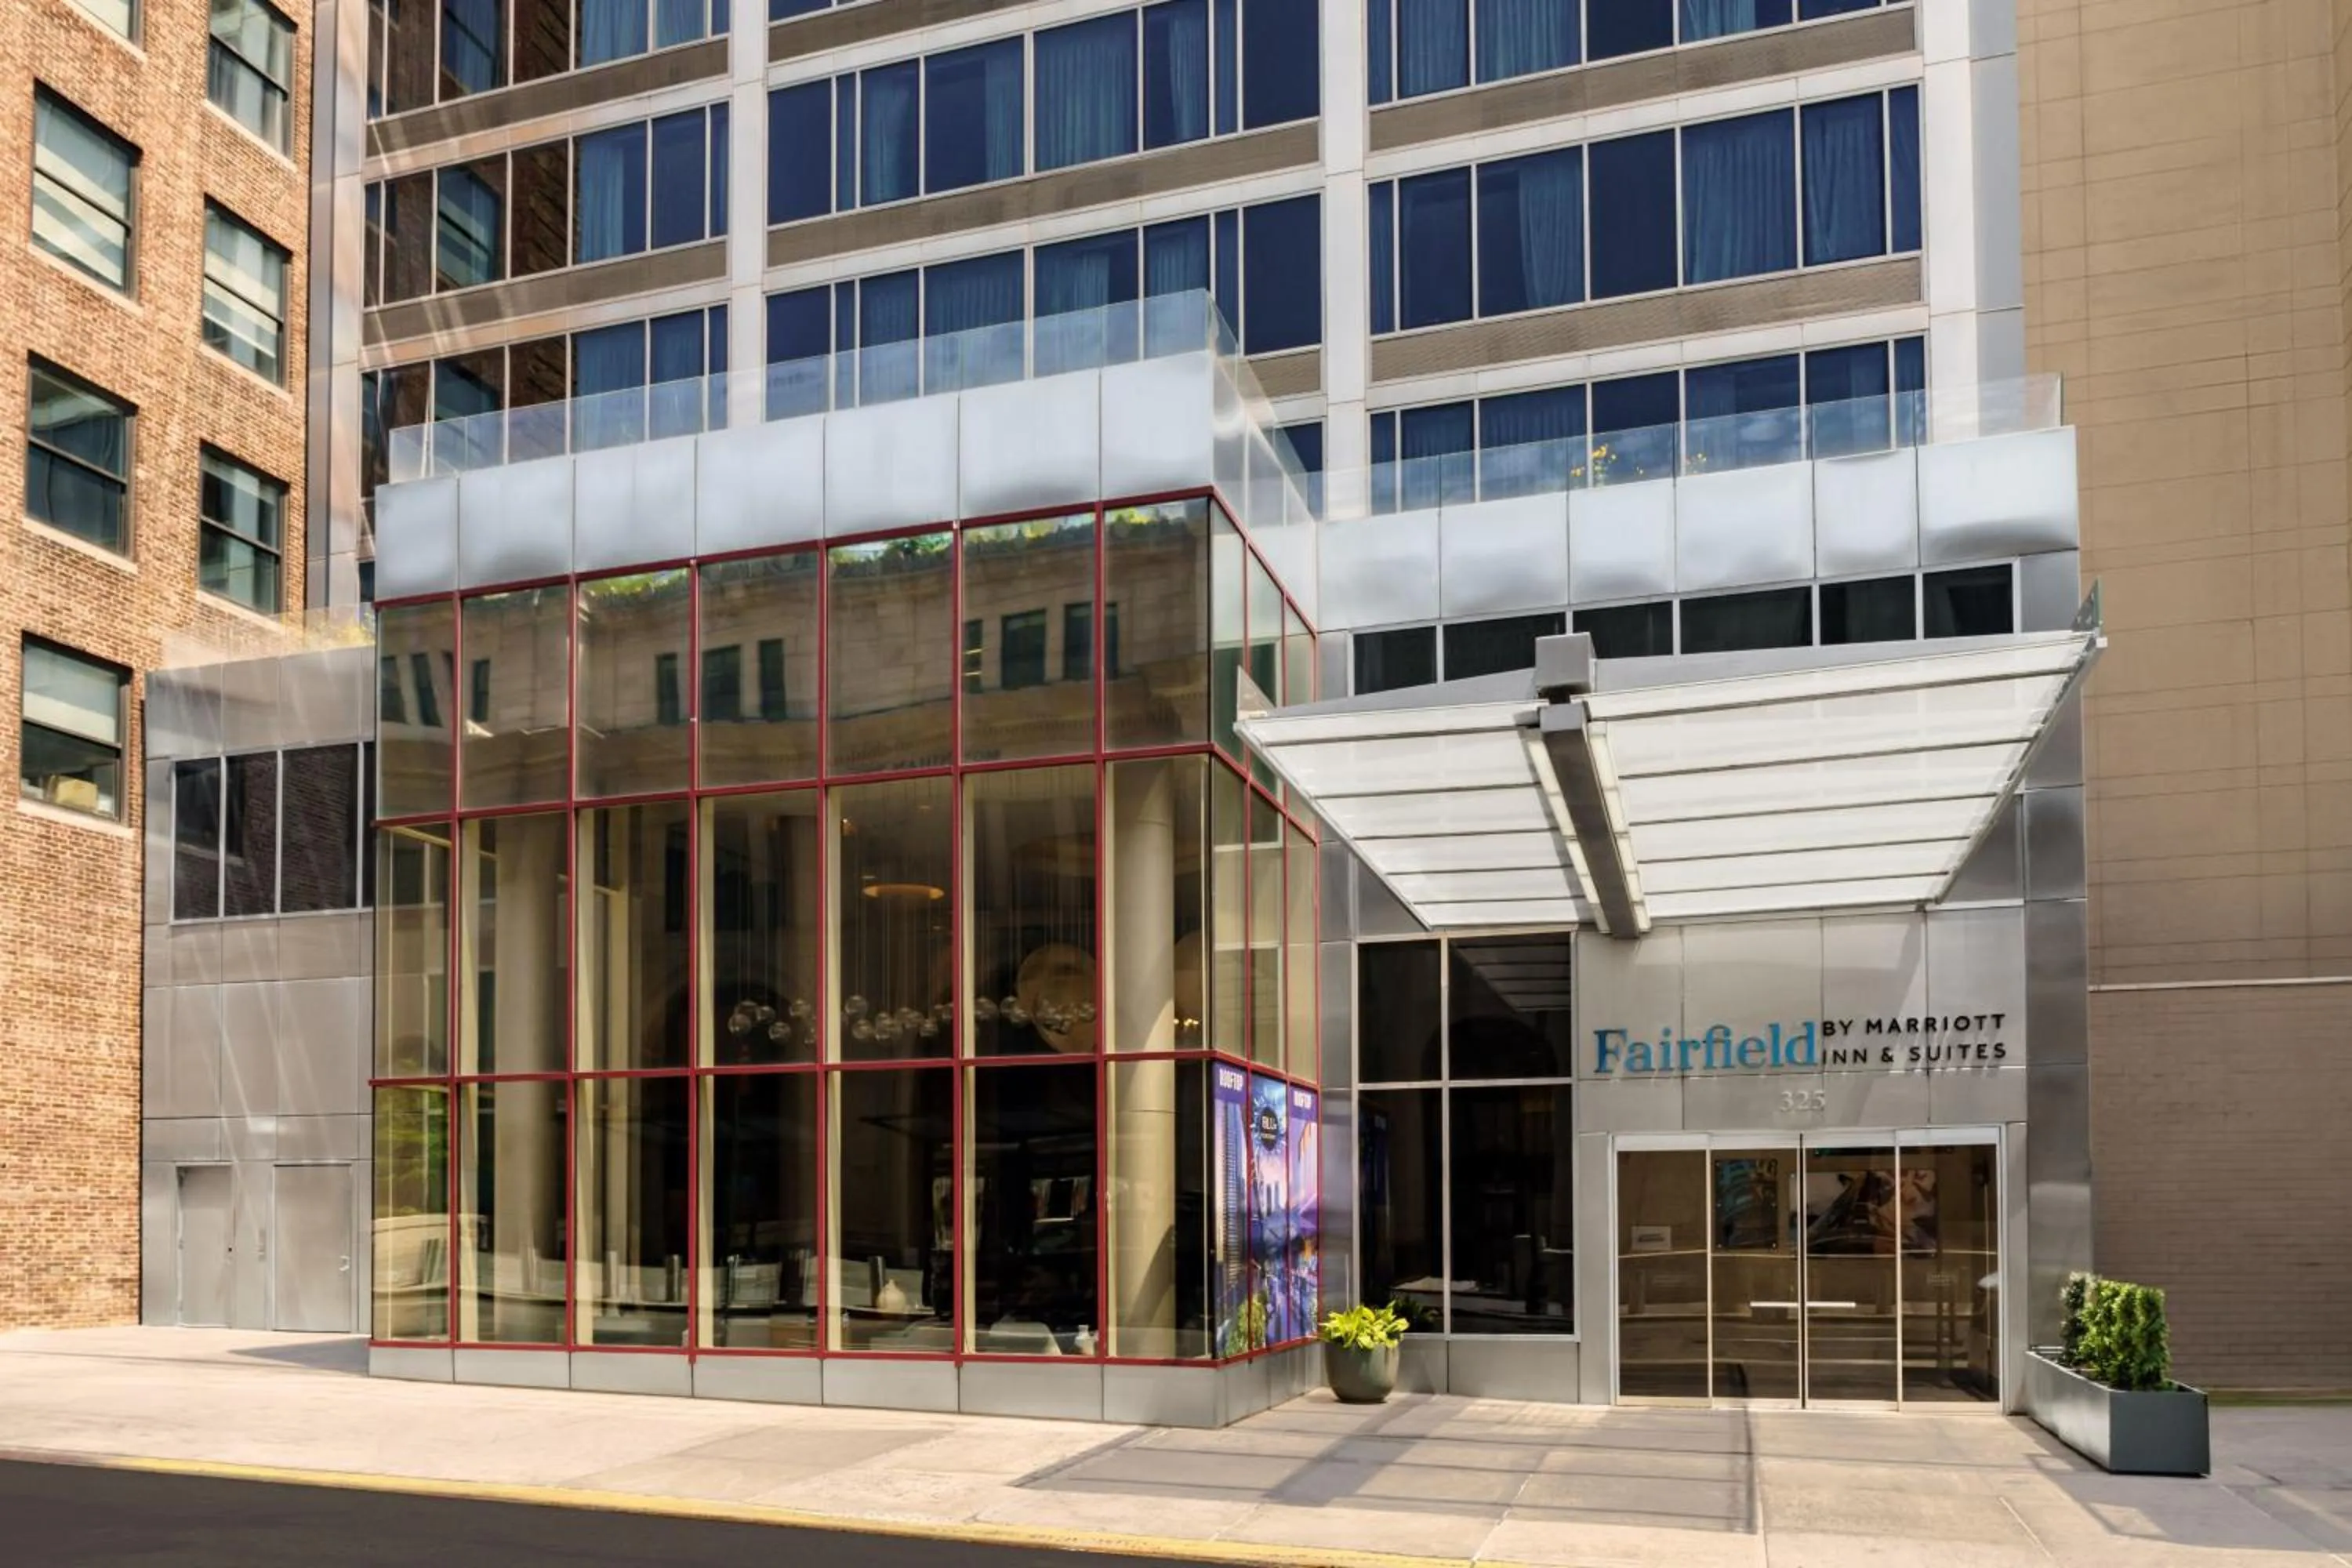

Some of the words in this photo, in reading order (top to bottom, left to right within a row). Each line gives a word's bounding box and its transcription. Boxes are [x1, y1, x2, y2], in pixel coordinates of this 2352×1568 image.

[1823, 1020, 1853, 1036] BY
[1866, 1014, 2005, 1035] MARRIOTT
[1593, 1022, 1817, 1073] Fairfield
[1823, 1048, 1867, 1065] INN
[1881, 1047, 1894, 1063] &
[1909, 1043, 2006, 1062] SUITES
[1779, 1090, 1827, 1112] 325
